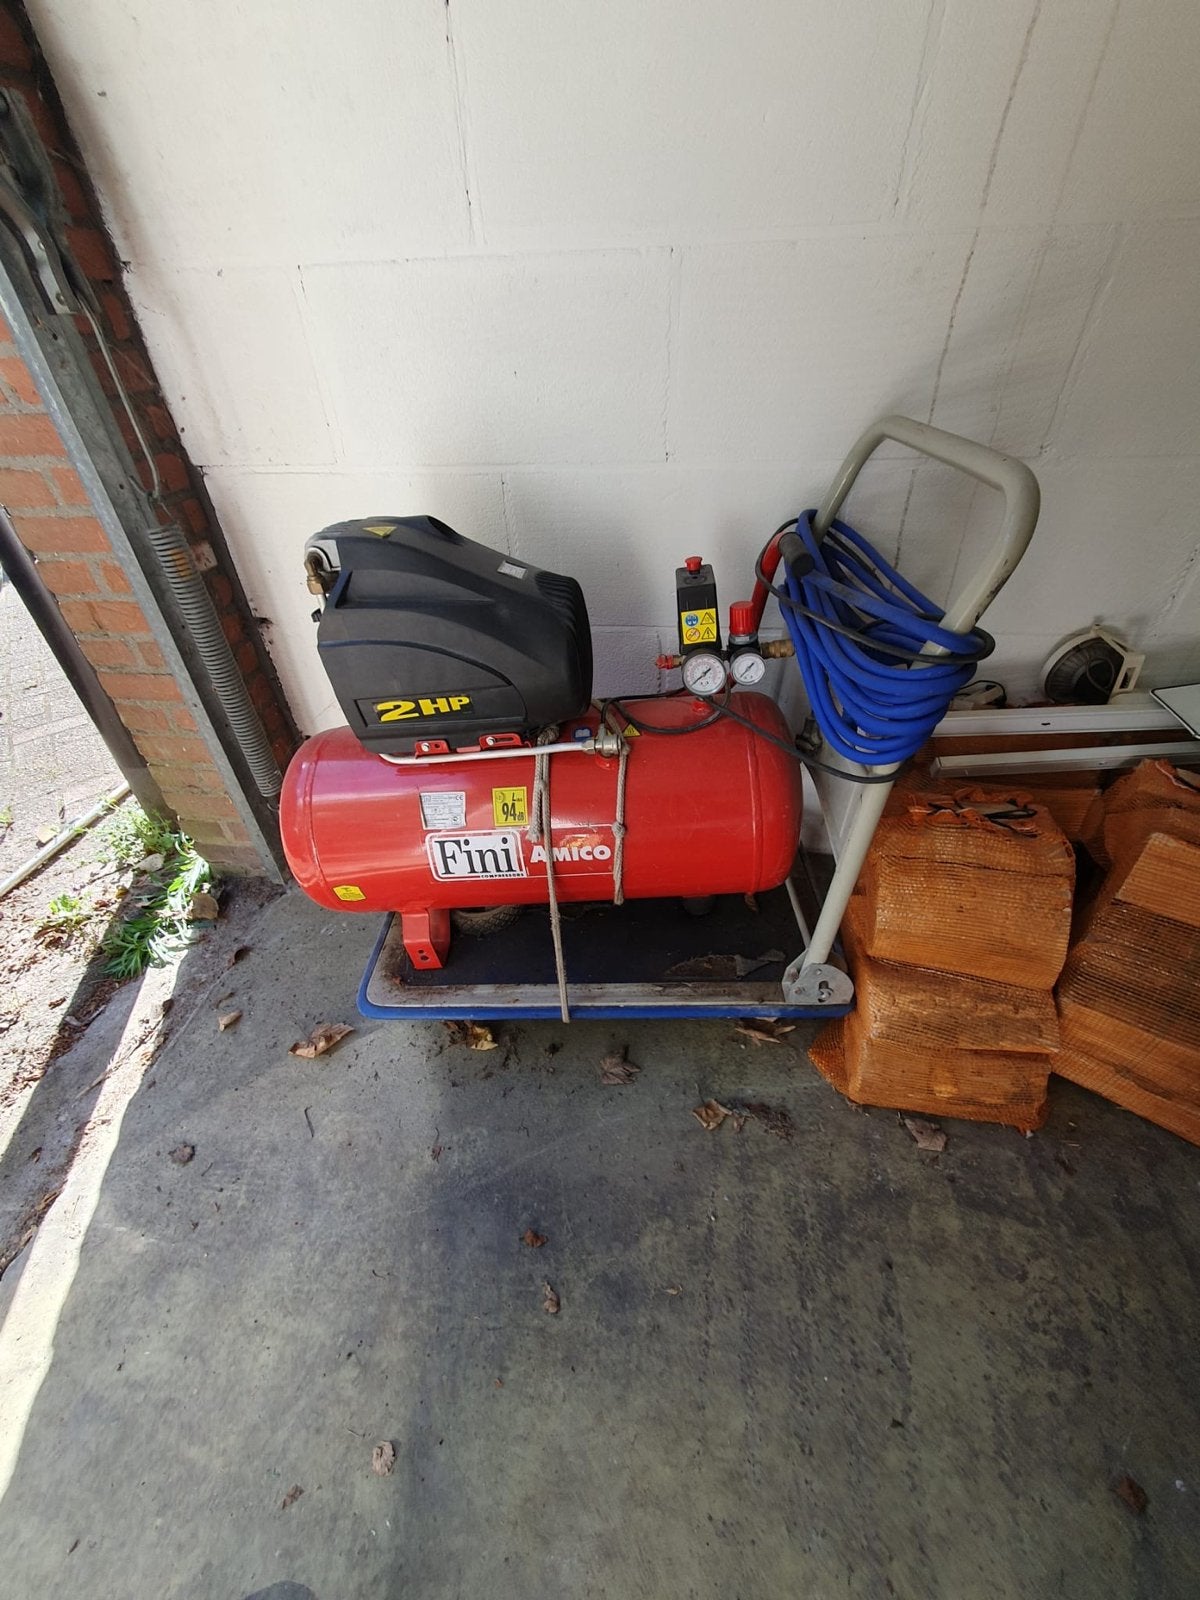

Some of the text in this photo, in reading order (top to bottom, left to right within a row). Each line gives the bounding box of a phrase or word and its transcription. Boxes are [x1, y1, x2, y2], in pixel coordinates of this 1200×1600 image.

[502, 802, 517, 821] 94
[434, 837, 517, 875] Fini
[530, 845, 611, 863] AMICO
